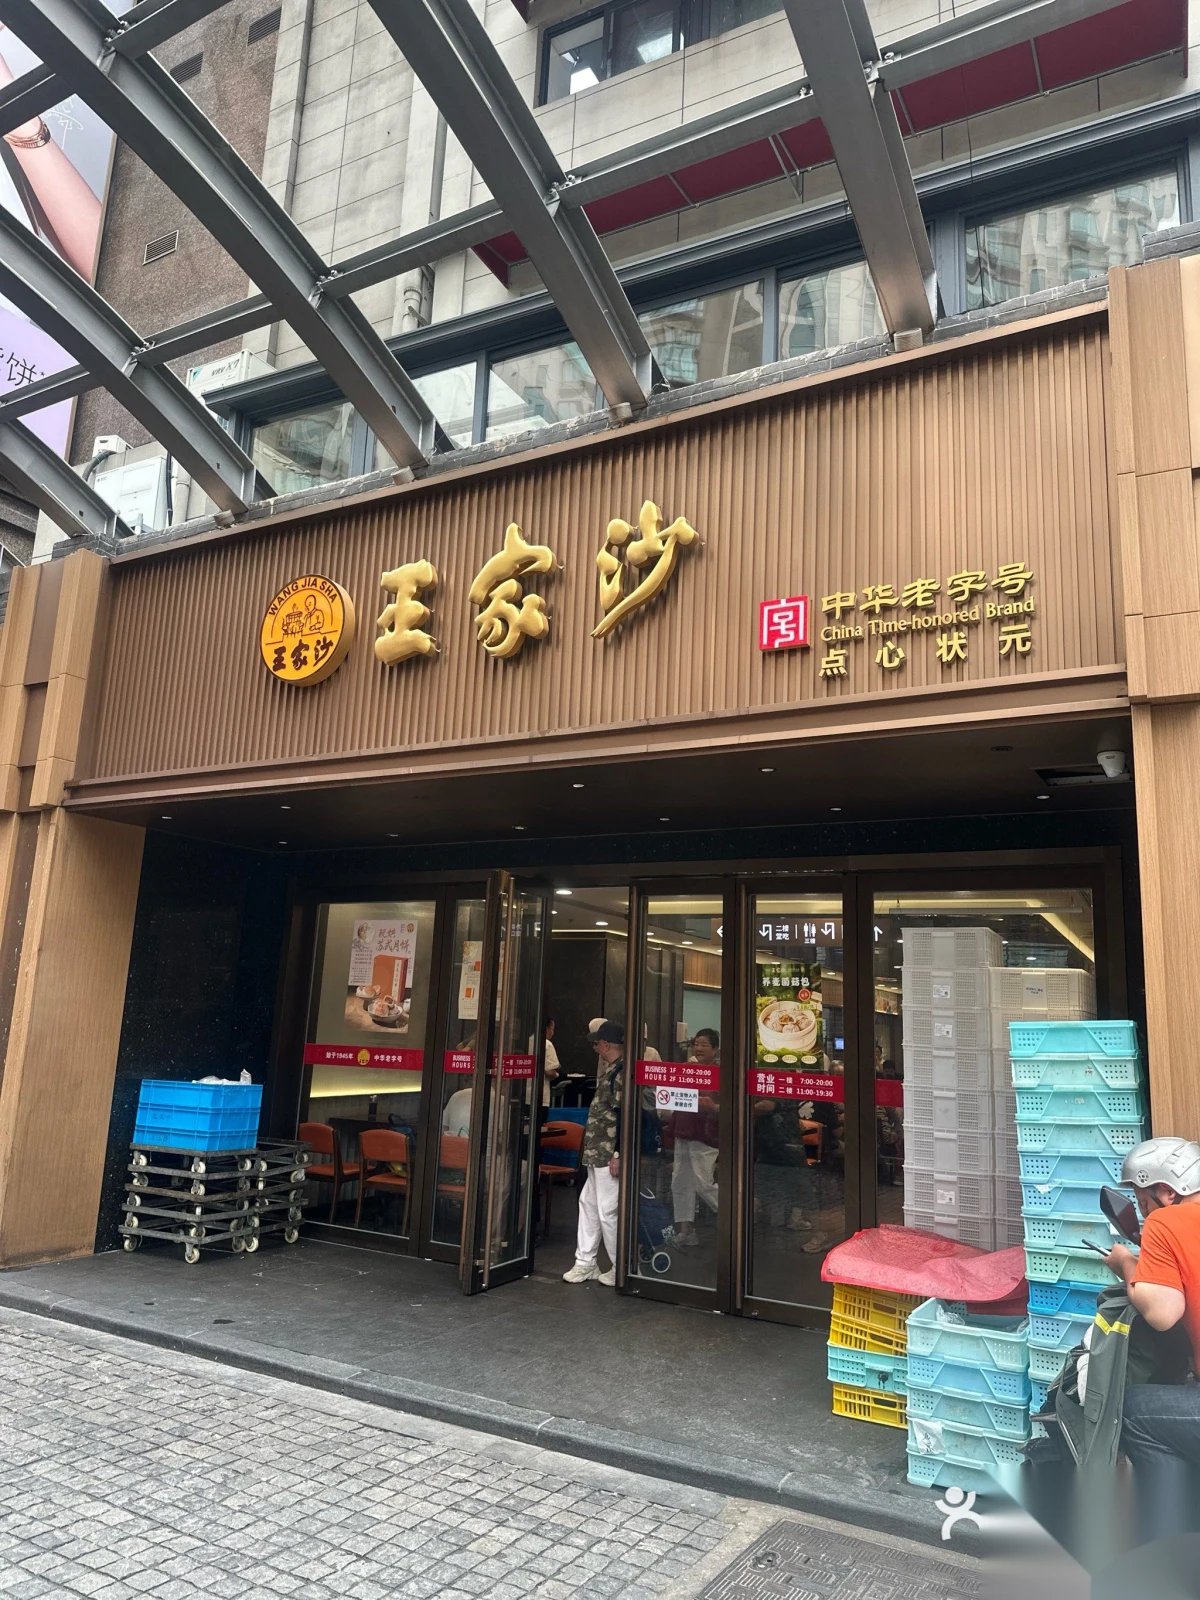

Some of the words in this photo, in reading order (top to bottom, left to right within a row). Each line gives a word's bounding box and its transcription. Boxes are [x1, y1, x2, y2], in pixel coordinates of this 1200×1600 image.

[0, 347, 37, 386] 饼
[375, 500, 699, 667] 王家沙
[821, 562, 1034, 620] 中华老字号
[269, 581, 298, 616] WANG
[301, 578, 317, 588] JIA
[320, 581, 338, 603] SHA
[820, 624, 863, 642] China
[868, 605, 980, 635] Time-honored
[985, 596, 1035, 619] Brand
[272, 635, 333, 672] 王家沙
[819, 624, 1033, 678] 点心状元
[762, 977, 810, 987] 荞麦菌菇包
[373, 1054, 403, 1063] 中华老字号
[452, 1054, 471, 1062] BUSINESS
[645, 1065, 667, 1073] BUSINESS
[682, 1068, 712, 1076] 7:00-20:00
[645, 1073, 666, 1081] HOURS
[679, 1077, 712, 1085] 11:00-19:30
[757, 1073, 775, 1083] 营业
[800, 1078, 834, 1087] 7:00-20:00
[757, 1084, 775, 1094] 时间
[797, 1088, 834, 1097] 11:00-19:30
